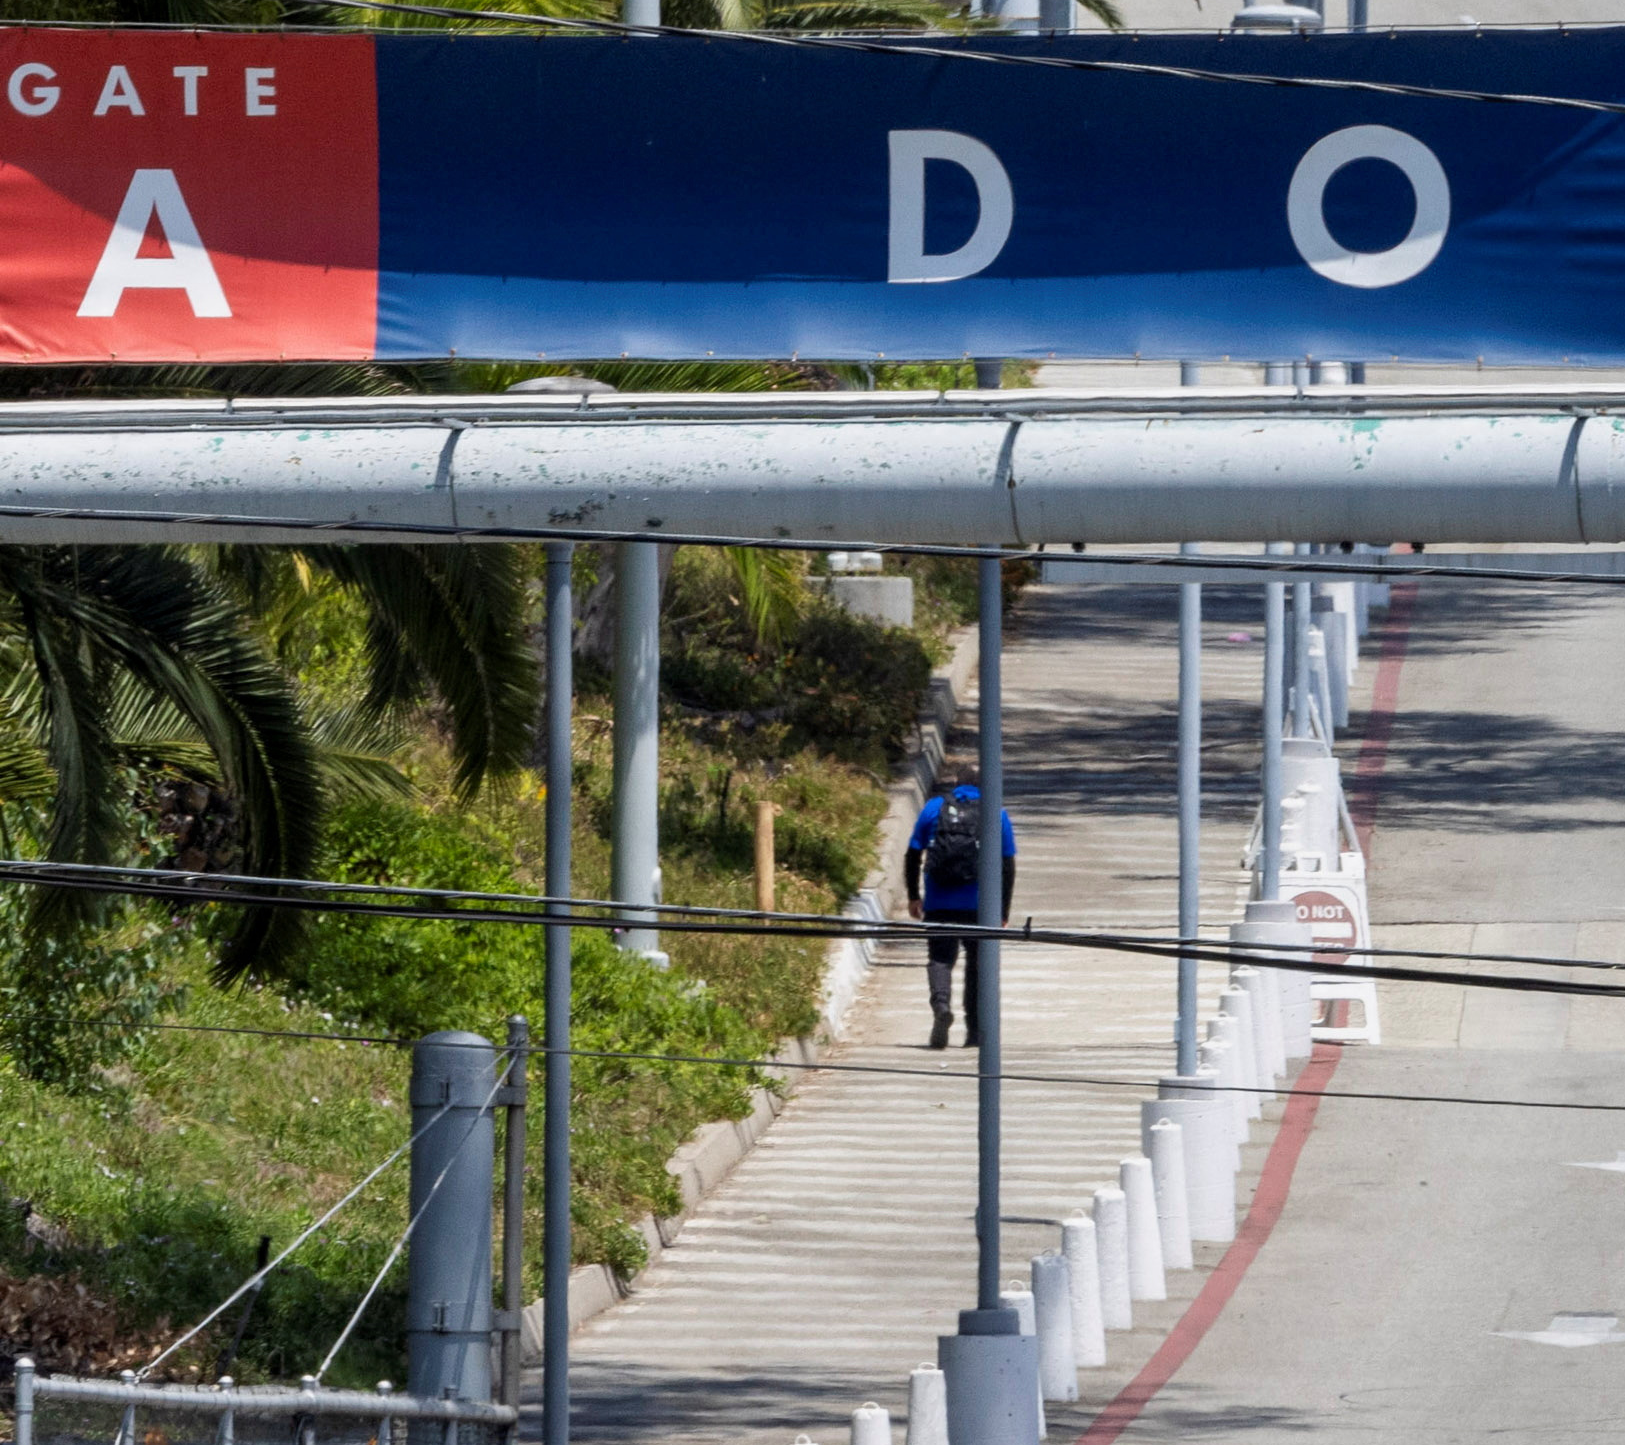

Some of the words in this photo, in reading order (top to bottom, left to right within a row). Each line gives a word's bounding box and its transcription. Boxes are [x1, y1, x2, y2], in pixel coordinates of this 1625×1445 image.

[7, 62, 277, 117] GATE
[76, 168, 234, 319] A
[1311, 905, 1345, 919] NOT
